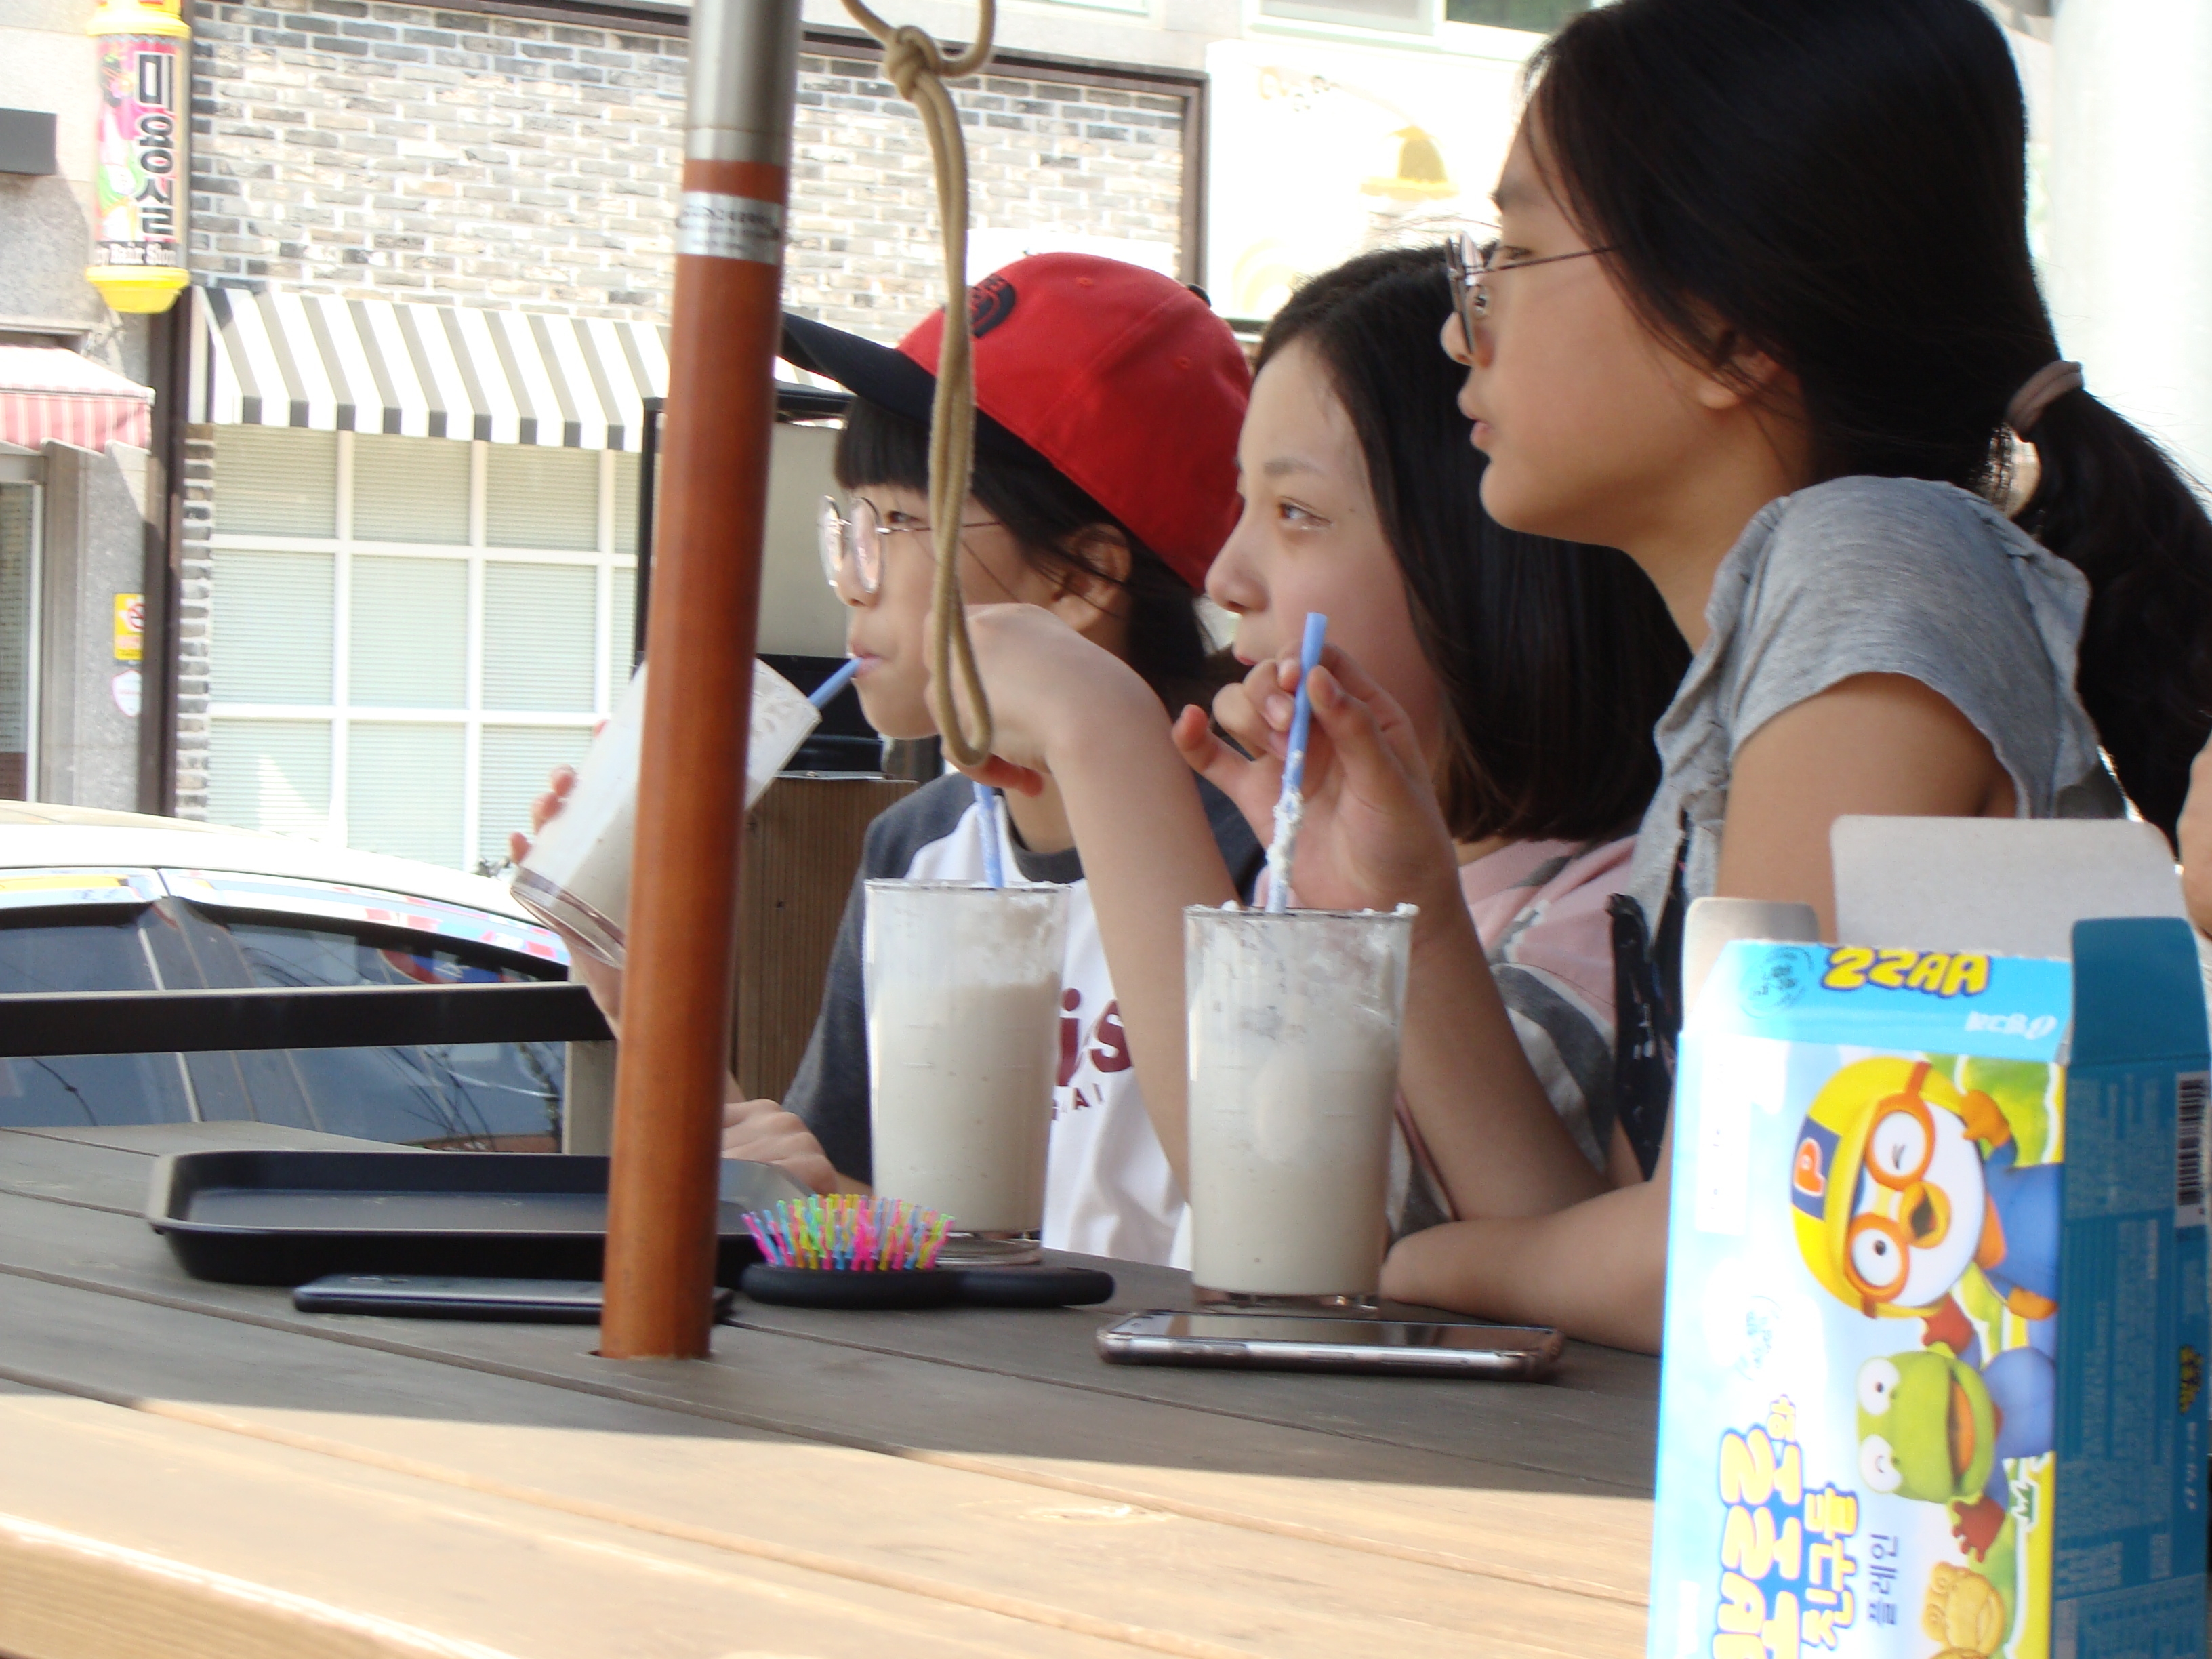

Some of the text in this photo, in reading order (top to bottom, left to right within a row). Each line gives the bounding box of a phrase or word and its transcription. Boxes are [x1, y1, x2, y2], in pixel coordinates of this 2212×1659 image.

[136, 52, 175, 237] 미용실
[1793, 1138, 1827, 1197] P
[1801, 1482, 1859, 1651] 친구들
[1867, 1533, 1899, 1626] 플레인
